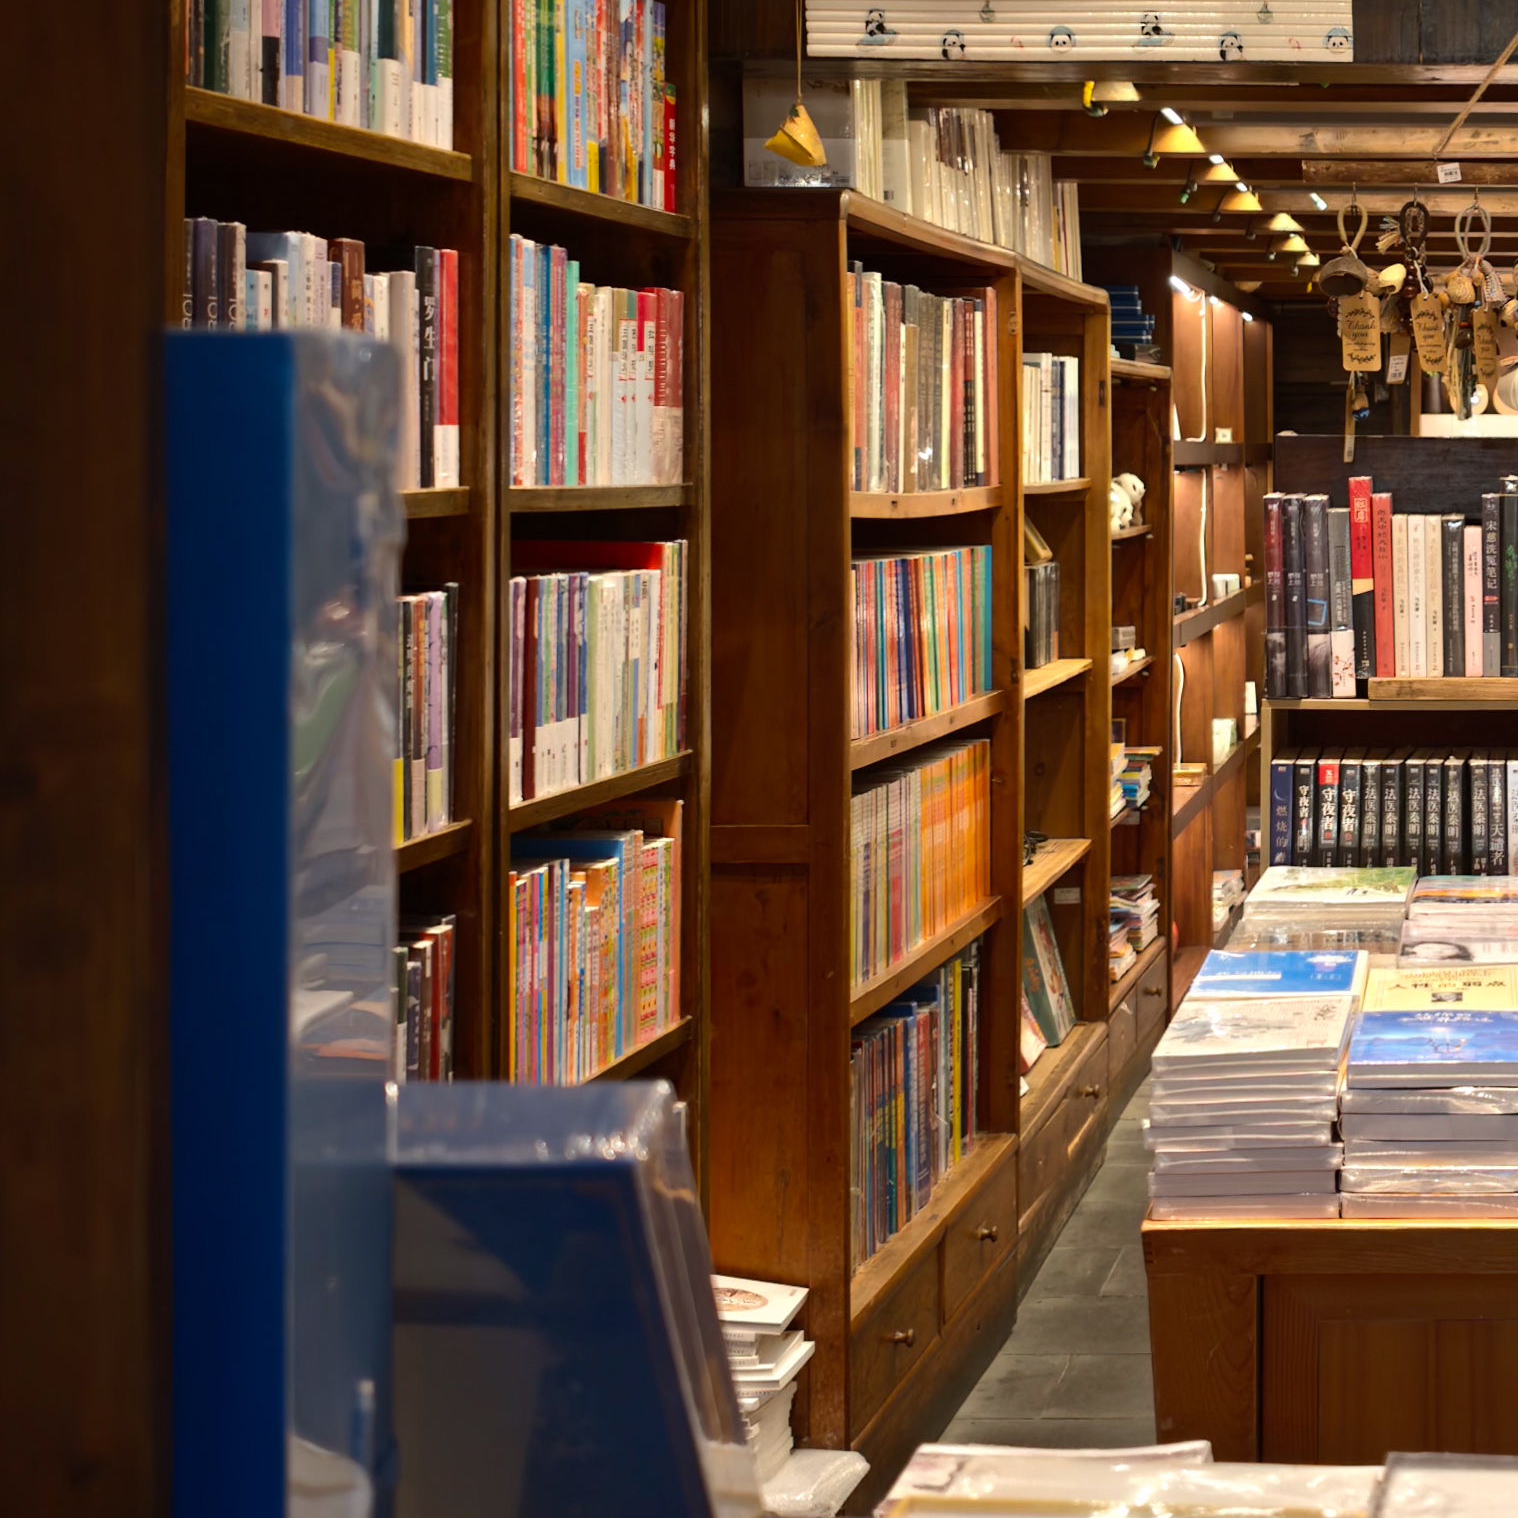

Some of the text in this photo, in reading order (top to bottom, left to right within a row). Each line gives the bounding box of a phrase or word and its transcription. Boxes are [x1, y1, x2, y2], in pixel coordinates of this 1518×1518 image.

[423, 296, 436, 381] 罗生门
[1486, 520, 1498, 590] 宋慈洗冤笔记
[1299, 785, 1310, 819] 守夜者
[1321, 788, 1336, 831] 守夜者
[1341, 788, 1357, 832] 守夜者
[1364, 787, 1376, 835] 法医秦明
[1384, 787, 1397, 835] 法医秦明
[1408, 787, 1421, 835] 法医秦明
[1427, 787, 1440, 835] 法医秦明
[1447, 789, 1459, 838] 法医秦明
[1473, 787, 1486, 835] 法医秦明
